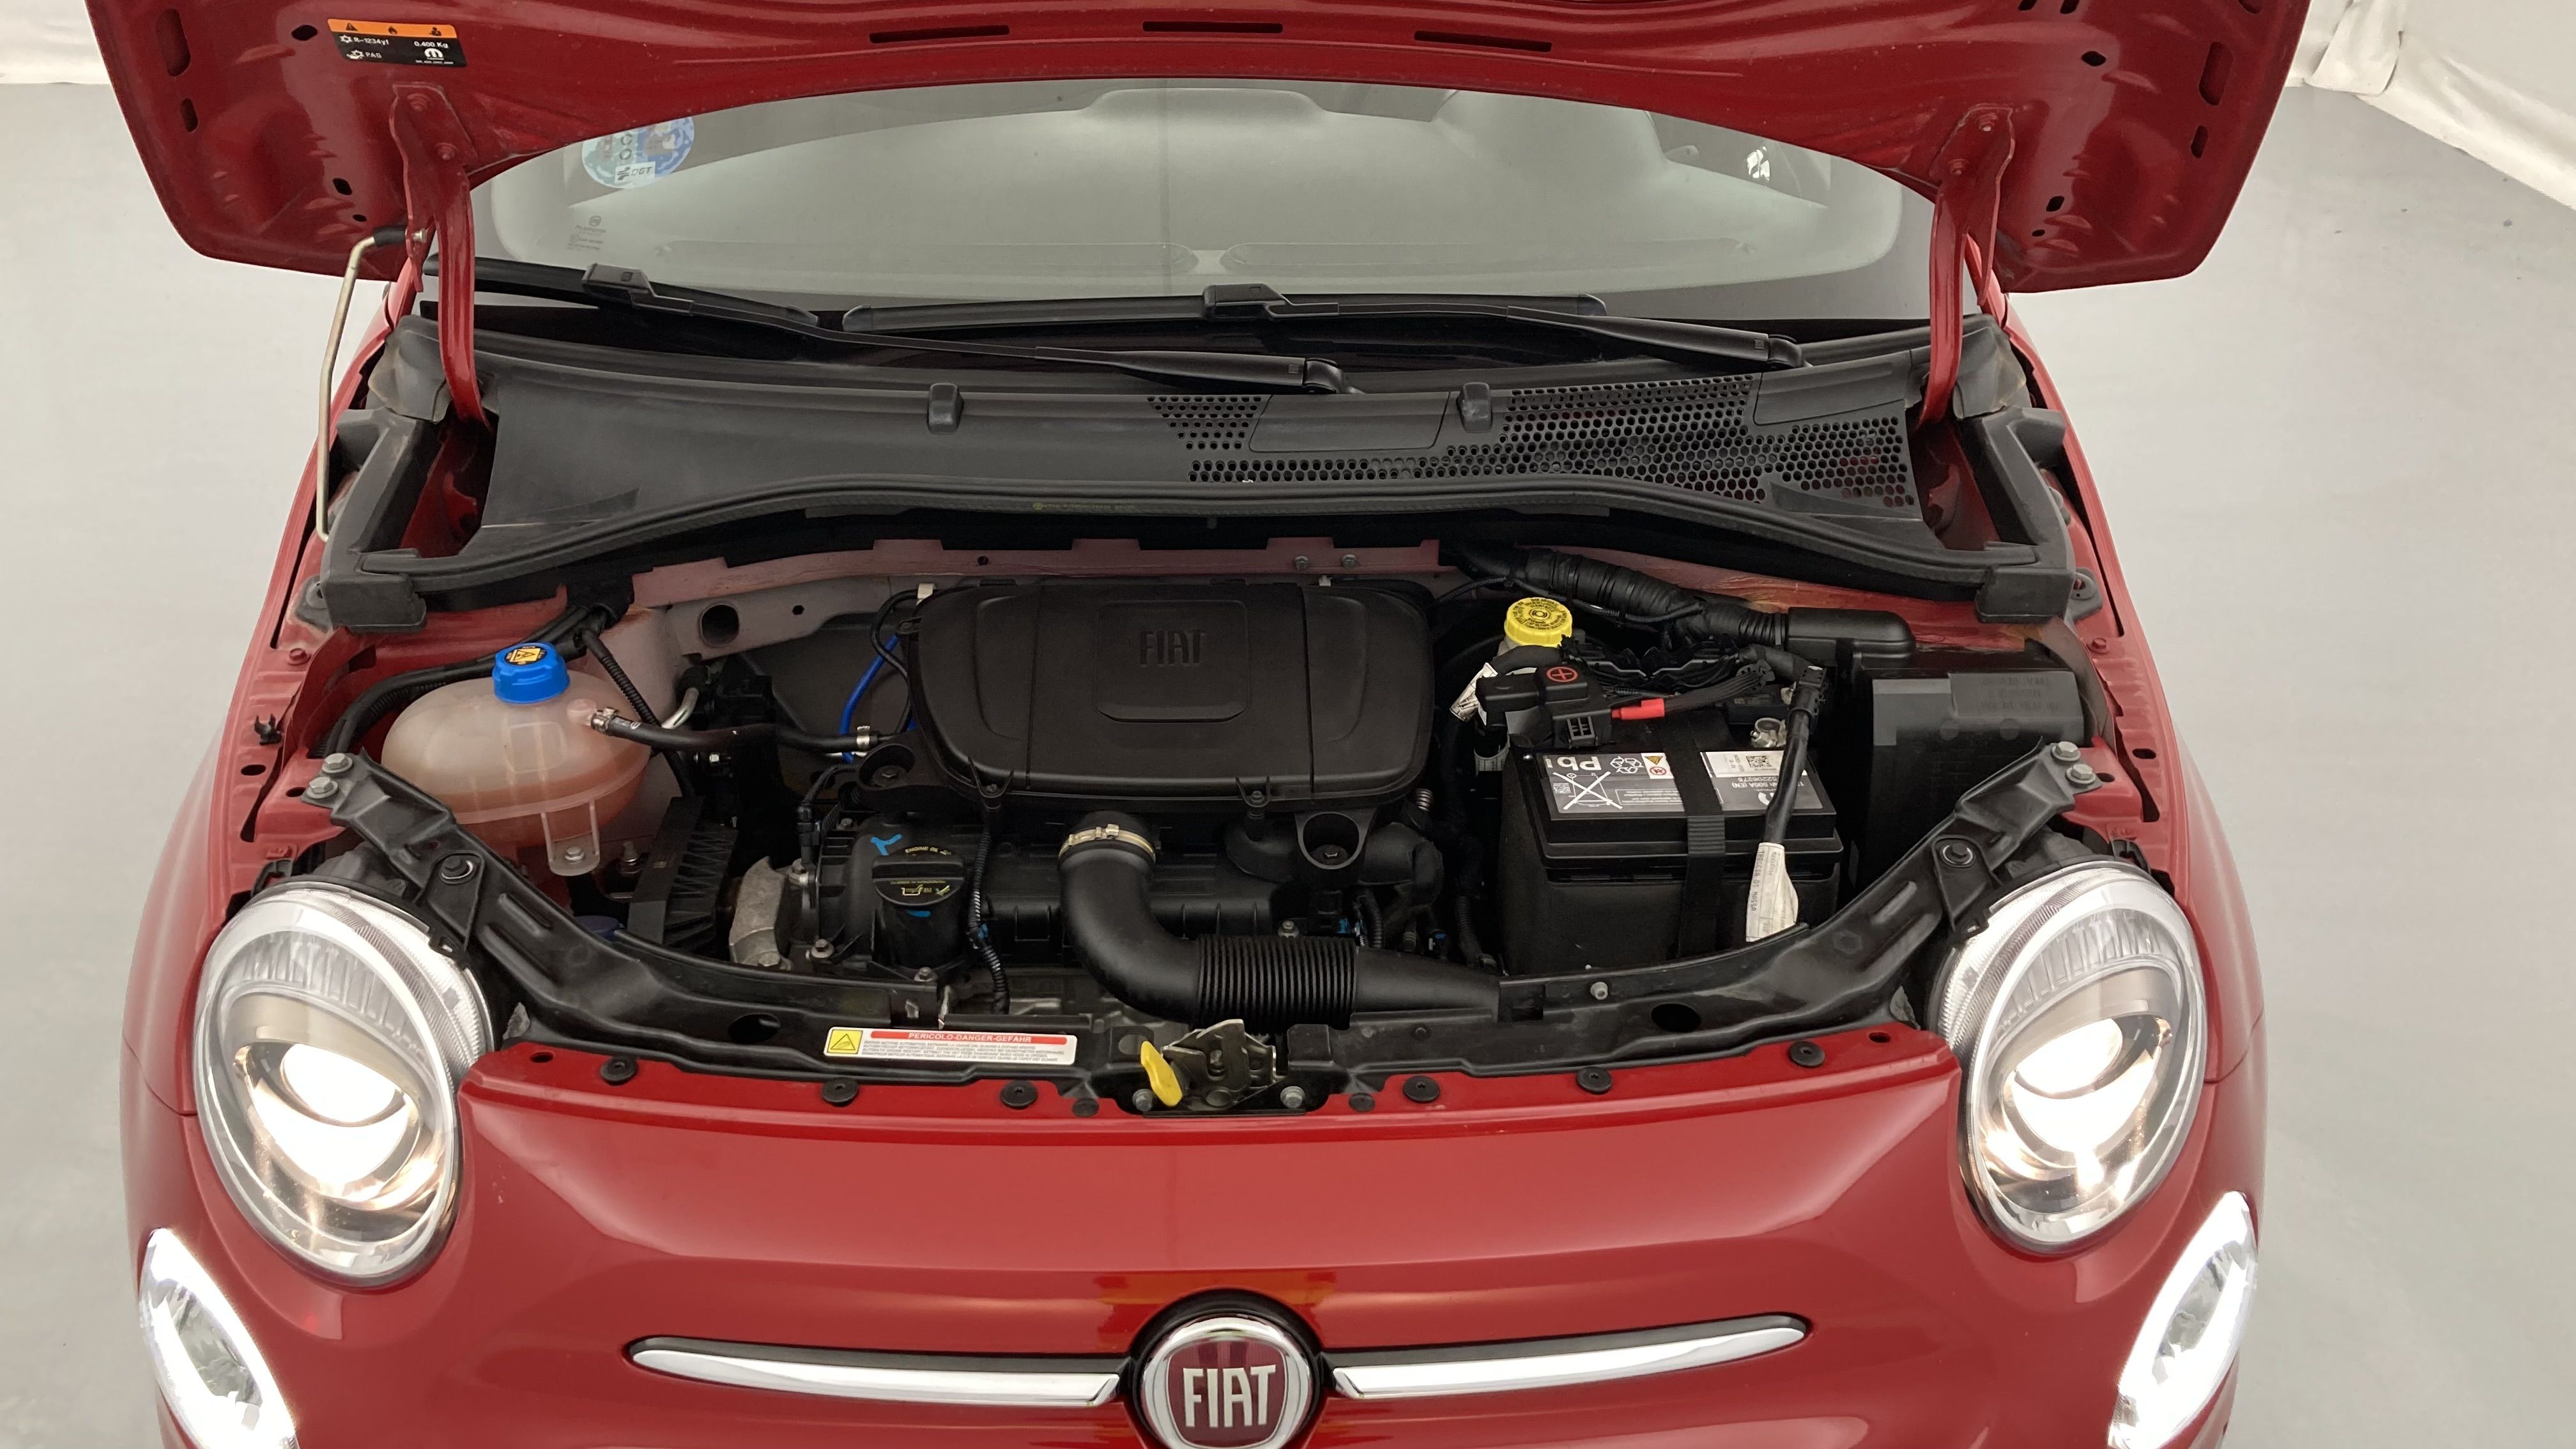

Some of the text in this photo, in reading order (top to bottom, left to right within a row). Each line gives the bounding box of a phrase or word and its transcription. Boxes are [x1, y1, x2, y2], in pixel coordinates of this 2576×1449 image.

[631, 166, 653, 176] DGT
[1139, 629, 1206, 665] FIAT
[1557, 756, 1602, 770] Pb
[908, 1032, 1032, 1043] PERICOLO-DANGER-GEFAHR
